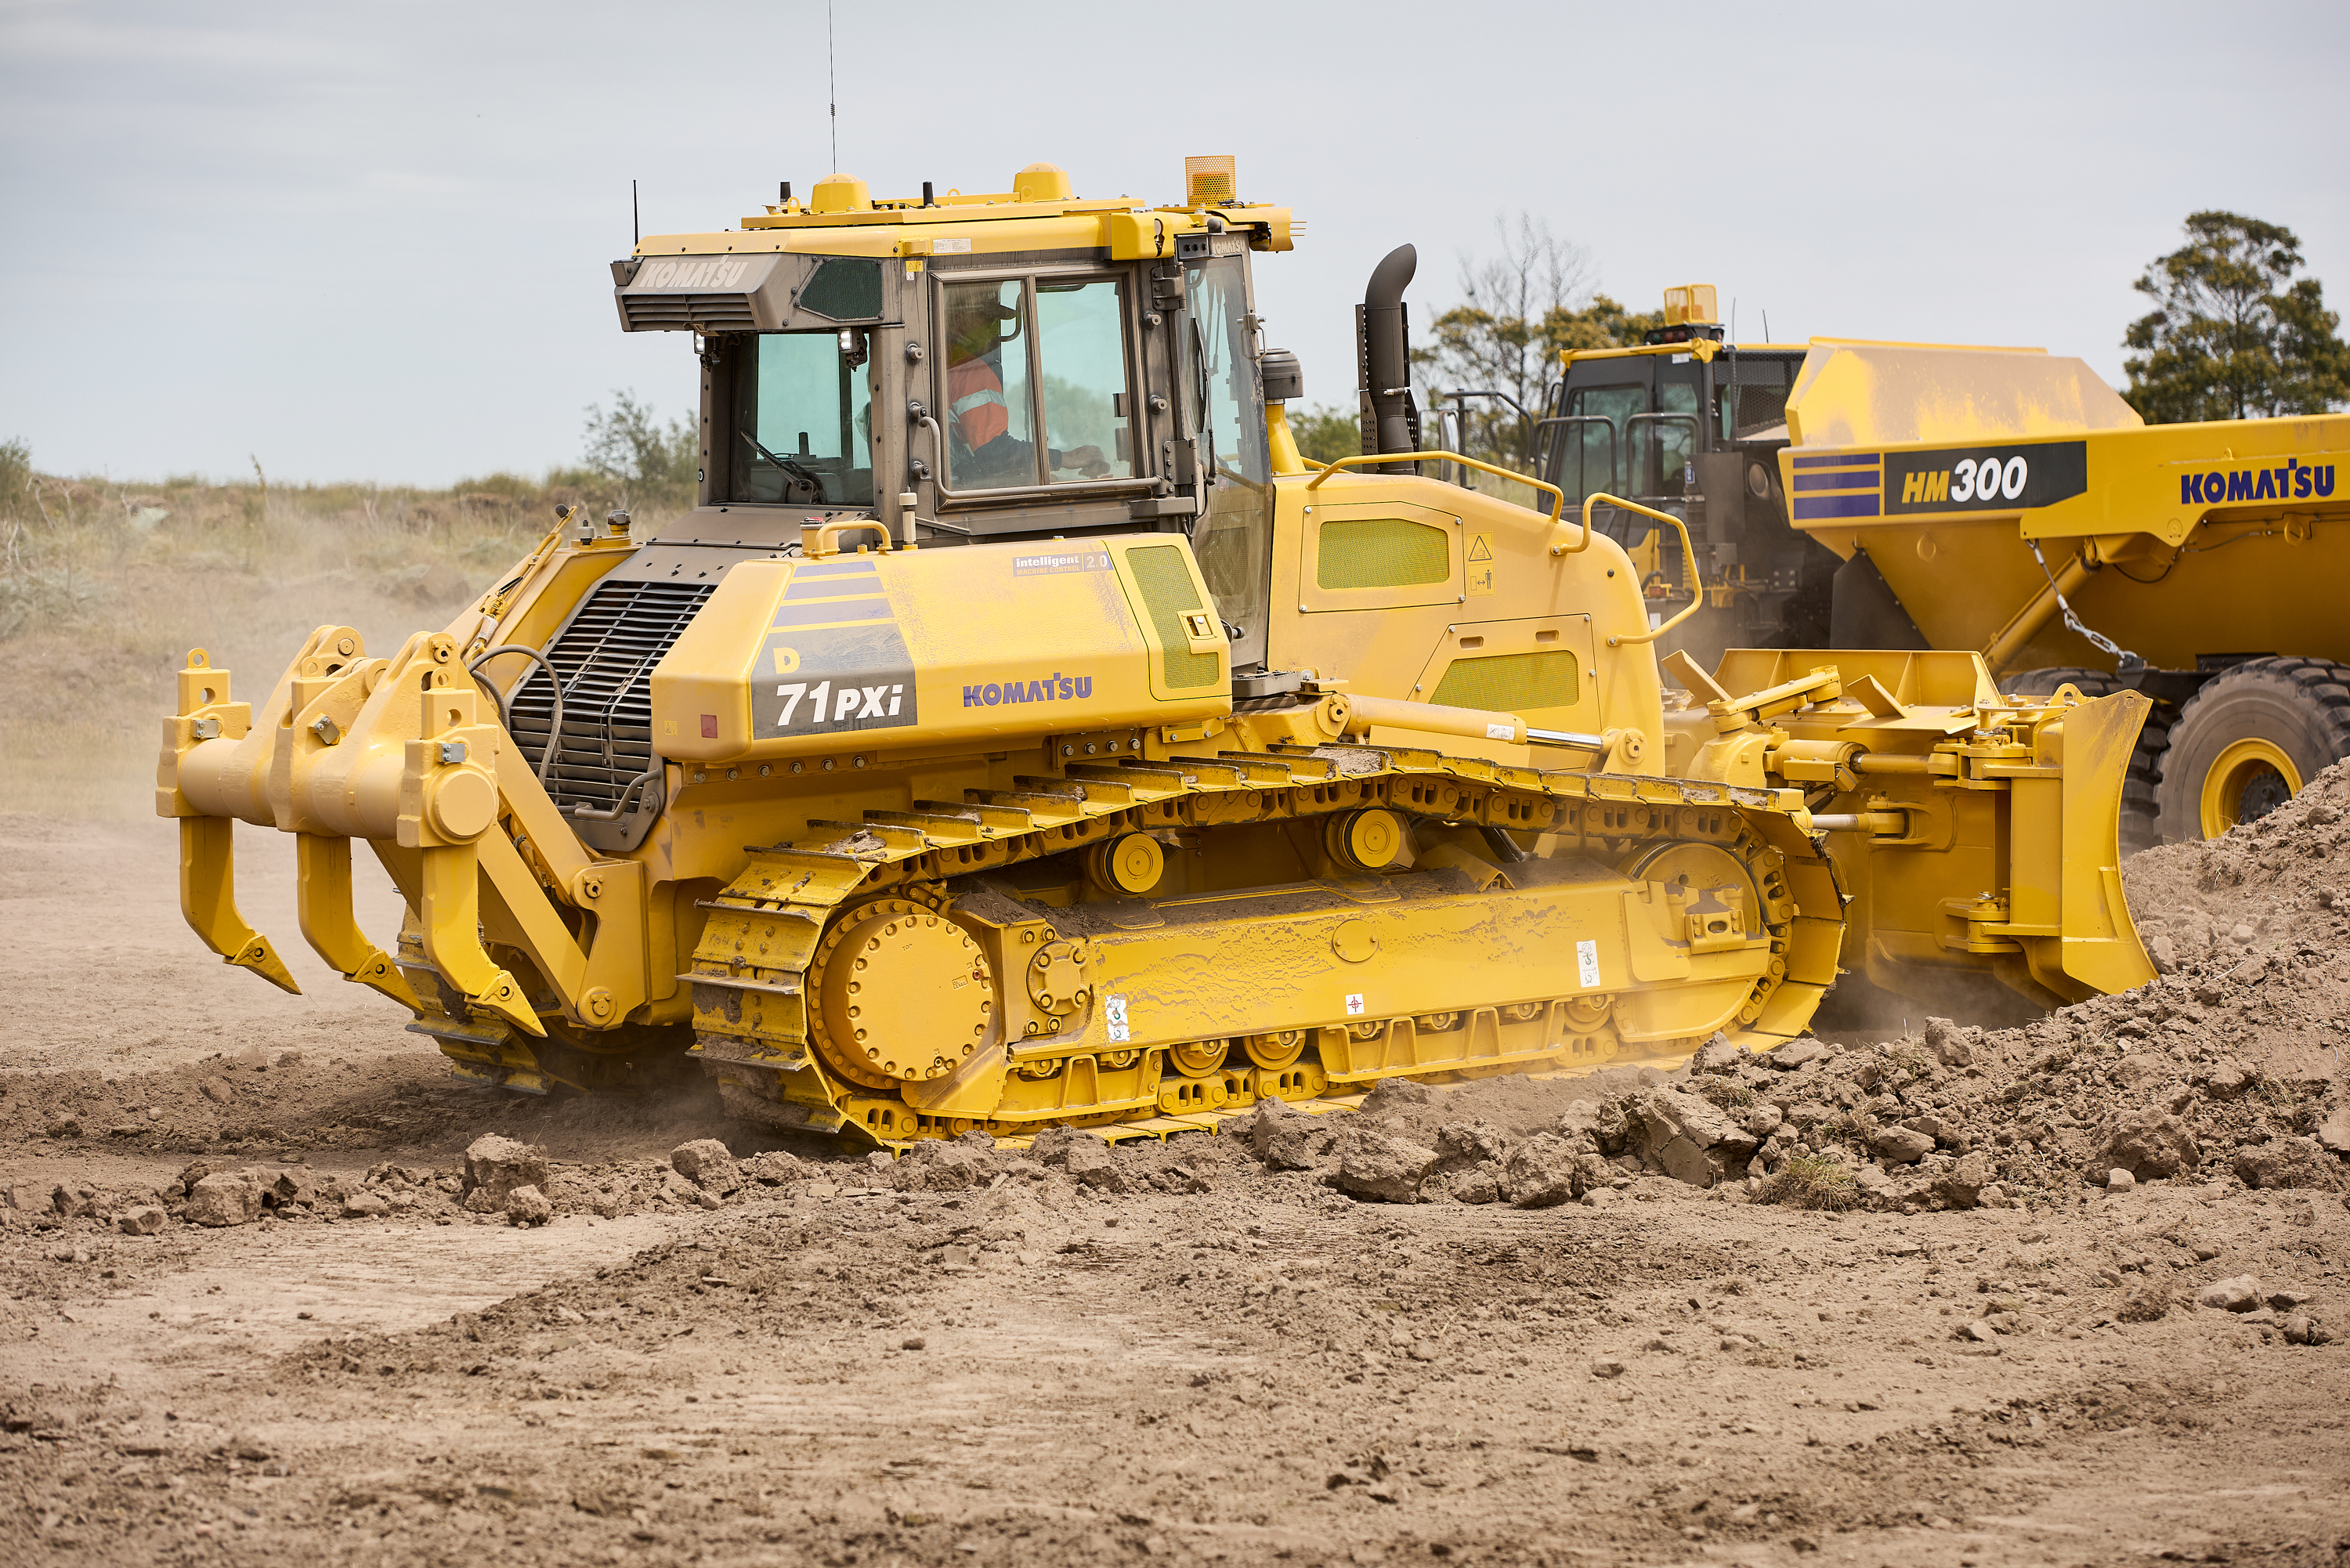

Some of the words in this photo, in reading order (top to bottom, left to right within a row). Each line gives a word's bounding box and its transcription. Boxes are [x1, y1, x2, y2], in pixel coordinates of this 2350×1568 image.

[638, 255, 749, 288] KOMATSU
[1902, 456, 2028, 503] HM300
[2181, 458, 2335, 504] KOMATSU
[1016, 555, 1079, 568] intelligent
[773, 647, 801, 674] D
[963, 672, 1092, 707] KOMATSU
[902, 943, 913, 952] TOP
